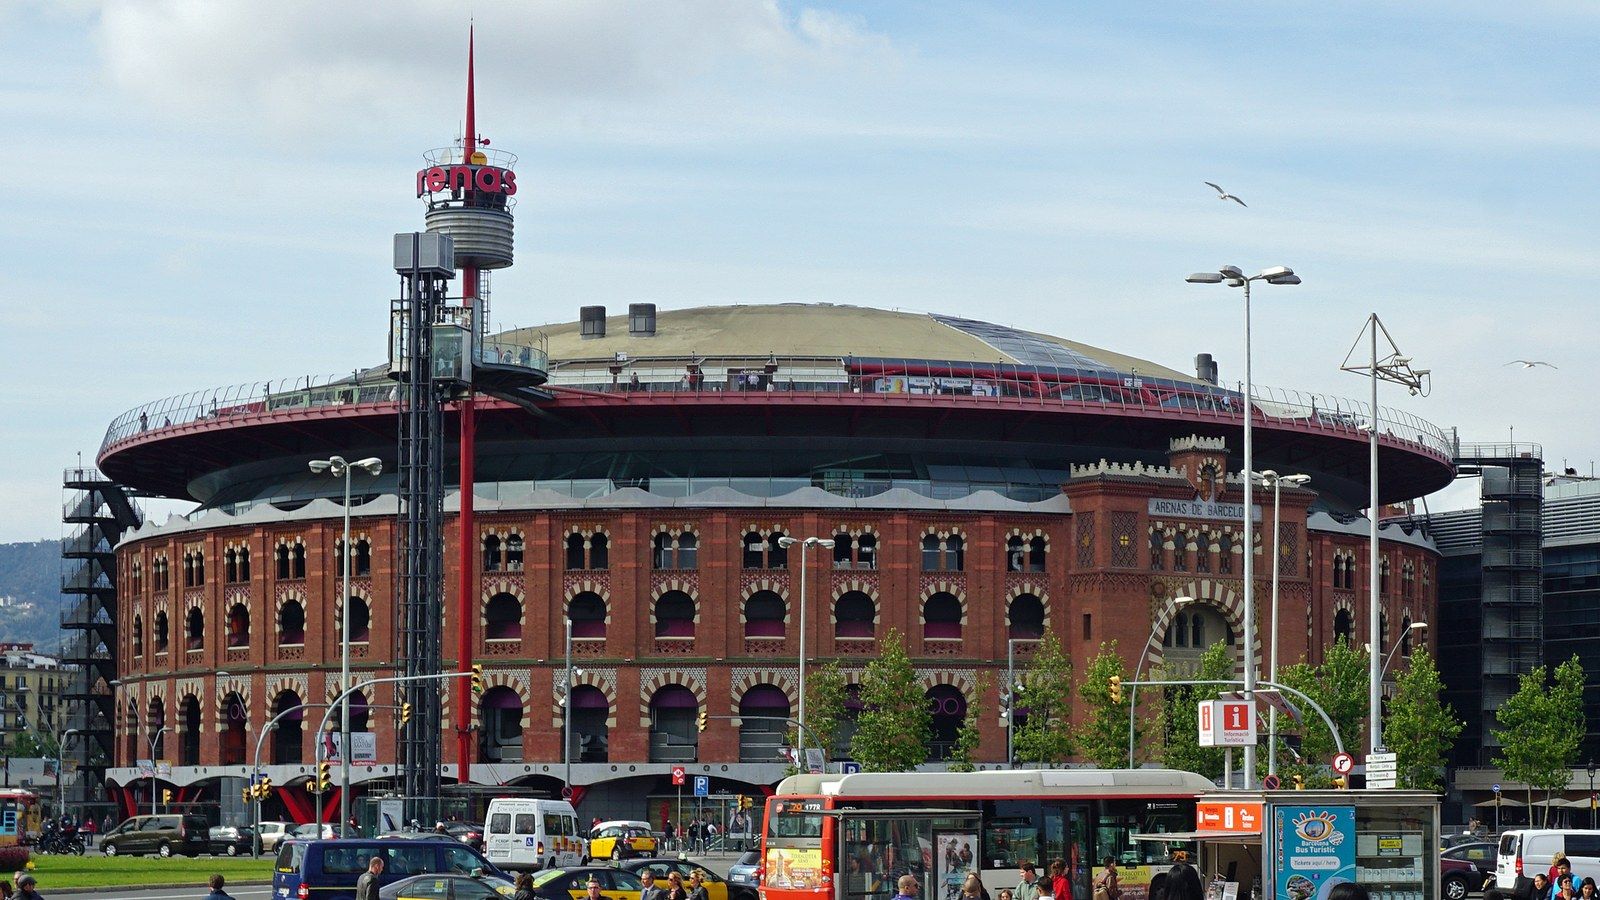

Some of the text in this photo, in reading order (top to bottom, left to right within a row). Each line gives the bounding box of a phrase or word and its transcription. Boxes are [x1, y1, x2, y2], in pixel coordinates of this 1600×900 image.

[1155, 501, 1245, 519] ARENAS DE BARCELO
[1173, 850, 1186, 861] 79
